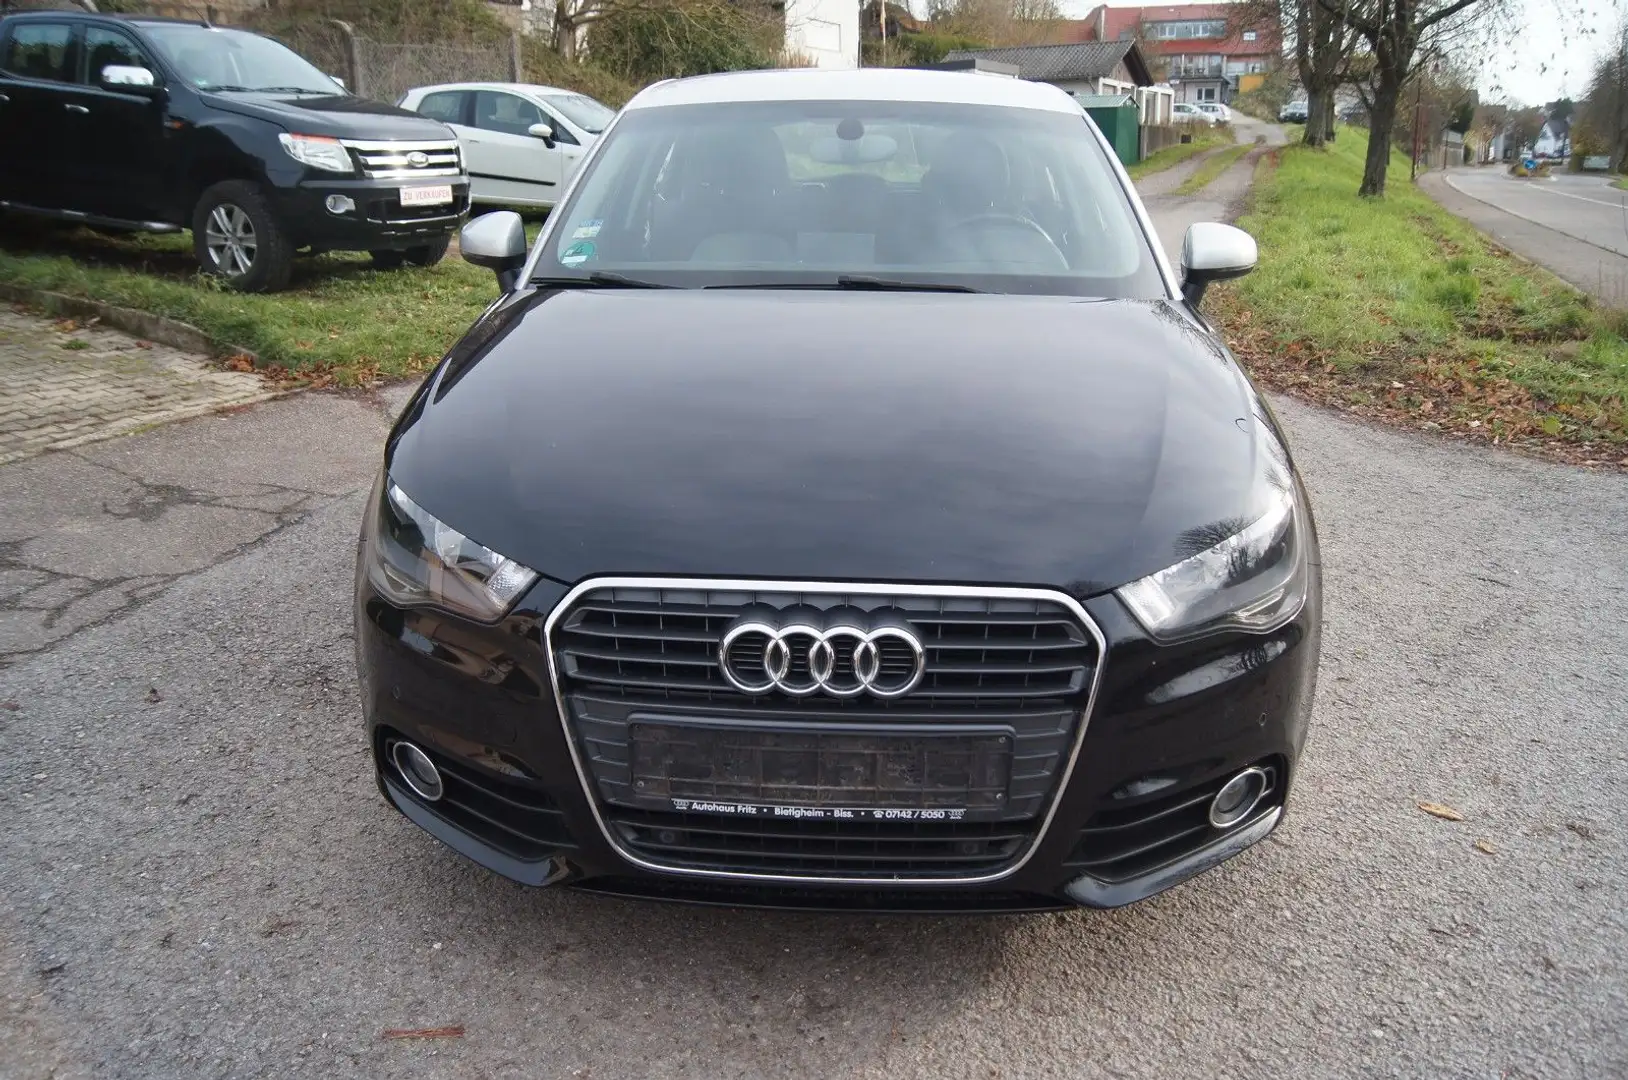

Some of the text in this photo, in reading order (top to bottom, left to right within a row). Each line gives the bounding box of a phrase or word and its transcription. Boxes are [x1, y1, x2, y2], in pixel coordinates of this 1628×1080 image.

[692, 802, 735, 813] Autohaus
[737, 805, 757, 814] Fritz
[774, 807, 824, 818] Bietigheim
[833, 808, 854, 818] Biss.
[920, 810, 945, 819] 5050
